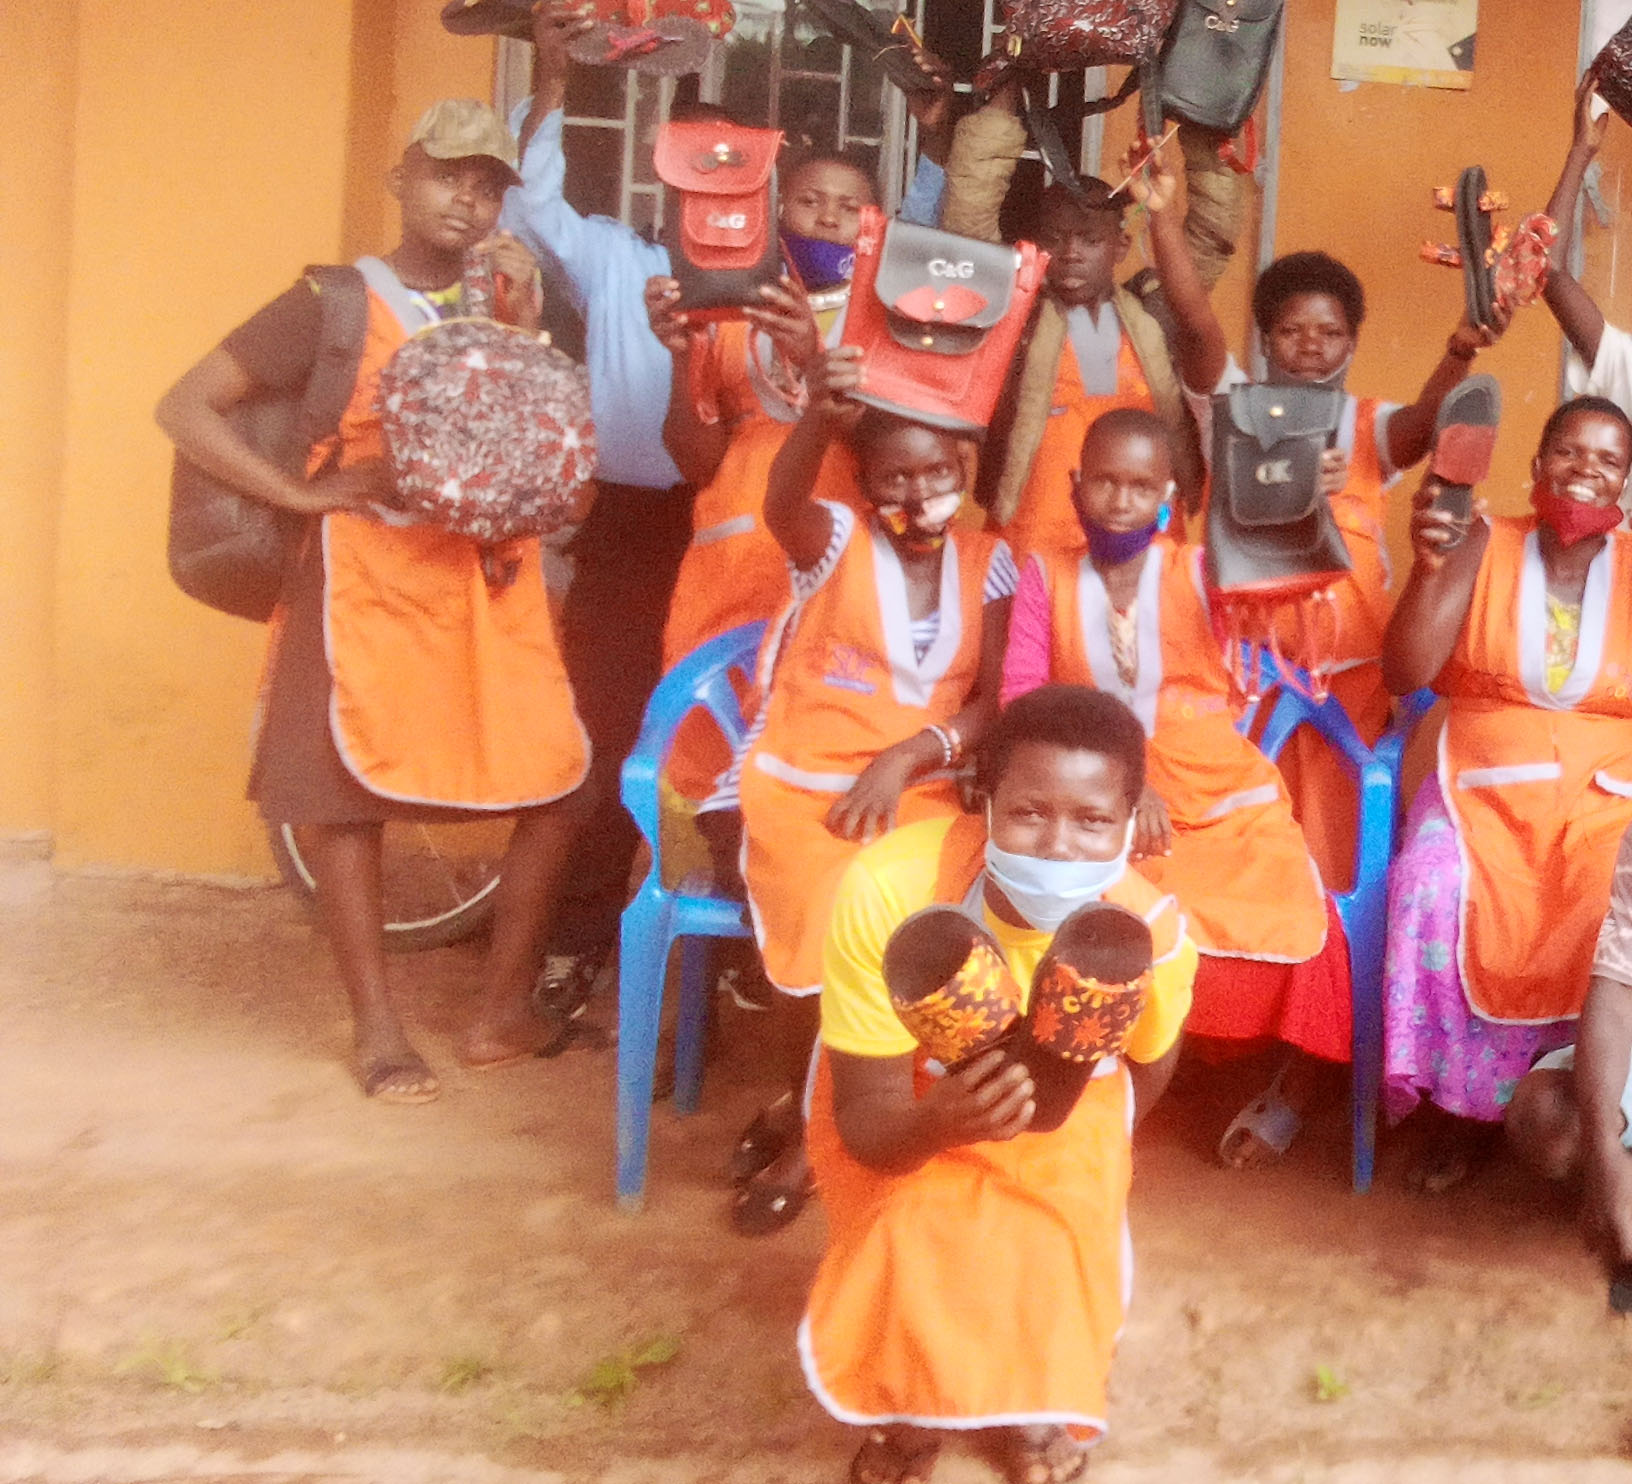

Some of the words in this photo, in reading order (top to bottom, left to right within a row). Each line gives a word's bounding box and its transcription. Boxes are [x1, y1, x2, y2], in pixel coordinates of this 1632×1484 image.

[1359, 22, 1397, 36] solar
[1359, 35, 1392, 48] now
[928, 258, 975, 279] C&G
